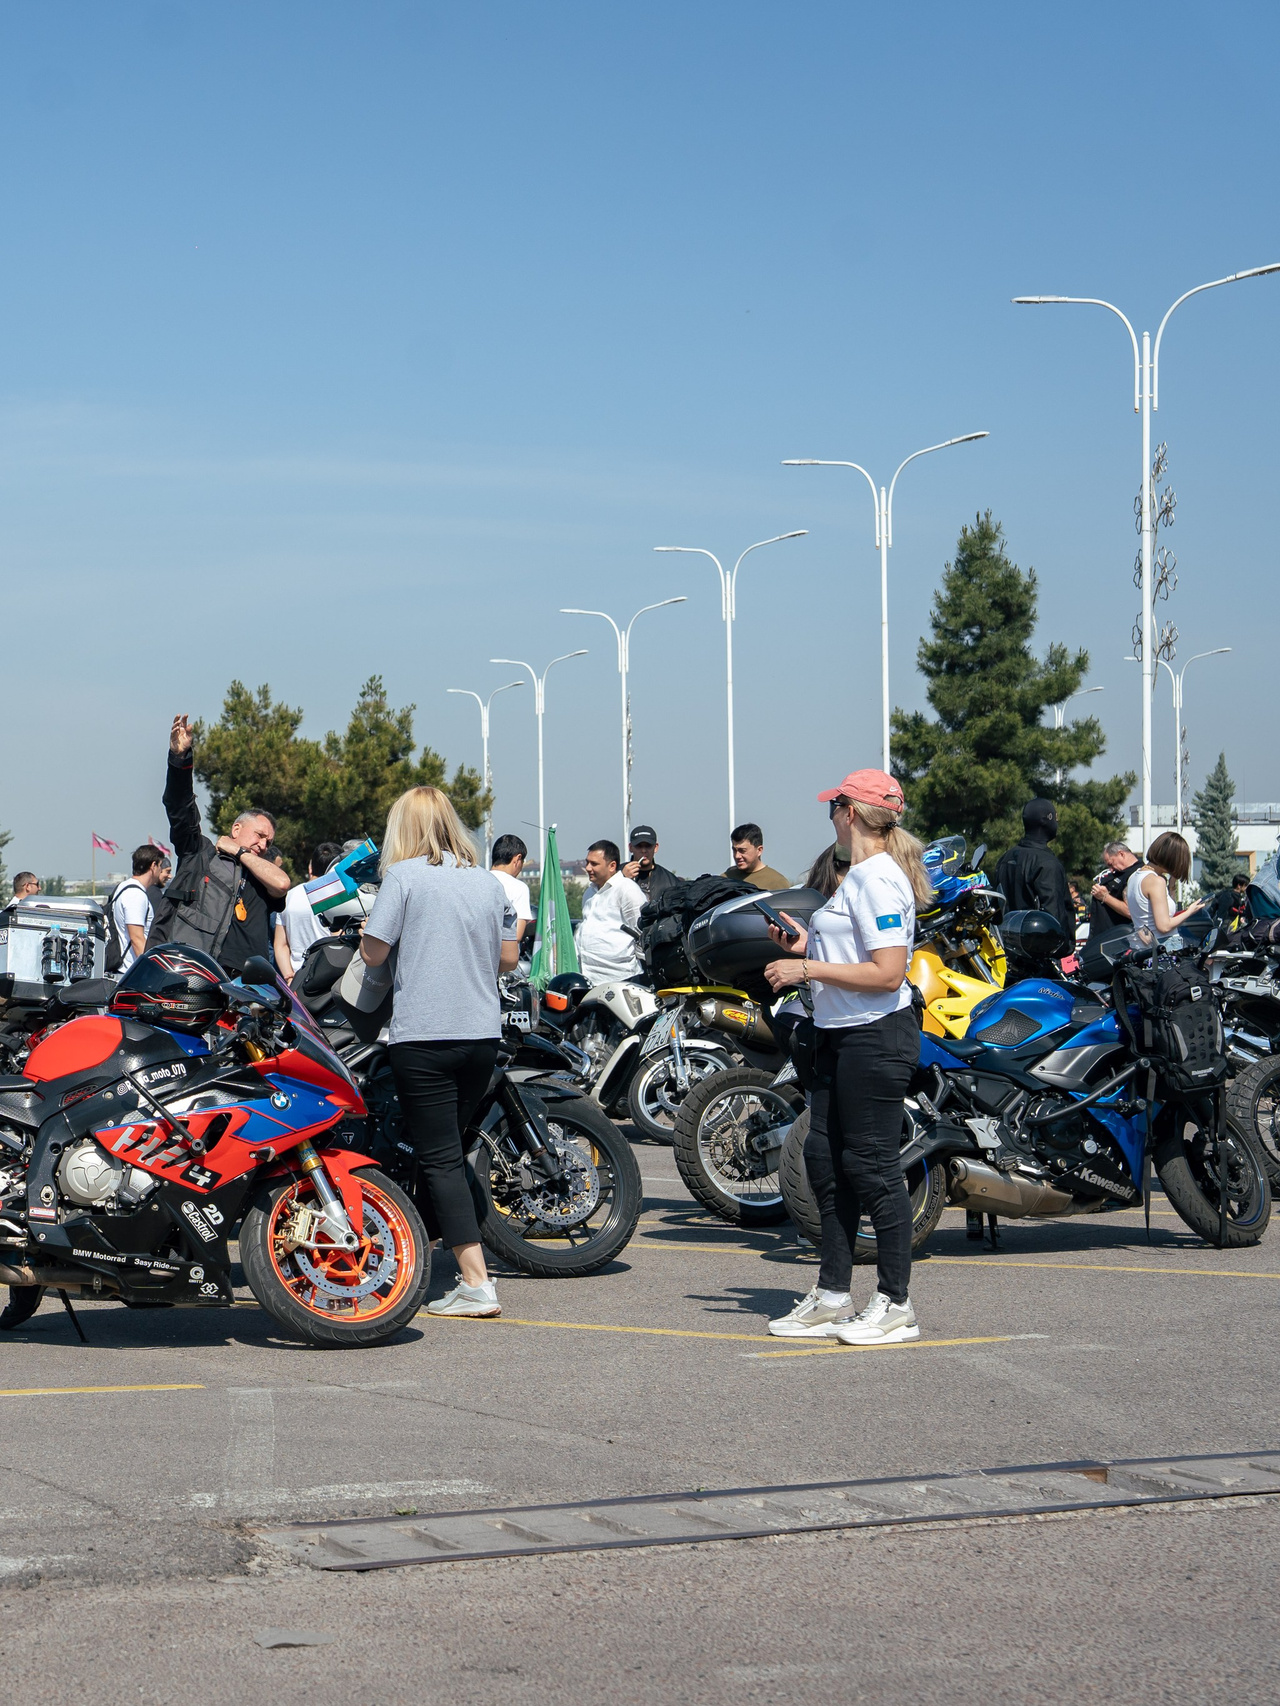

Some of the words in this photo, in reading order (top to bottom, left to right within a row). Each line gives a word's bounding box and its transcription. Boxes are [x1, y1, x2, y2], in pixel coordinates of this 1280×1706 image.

[1079, 1167, 1136, 1199] Kawasaki
[188, 1211, 216, 1241] Castrol
[202, 1203, 224, 1226] 2D
[72, 1248, 92, 1258] BMW
[92, 1251, 126, 1263] Motorrad
